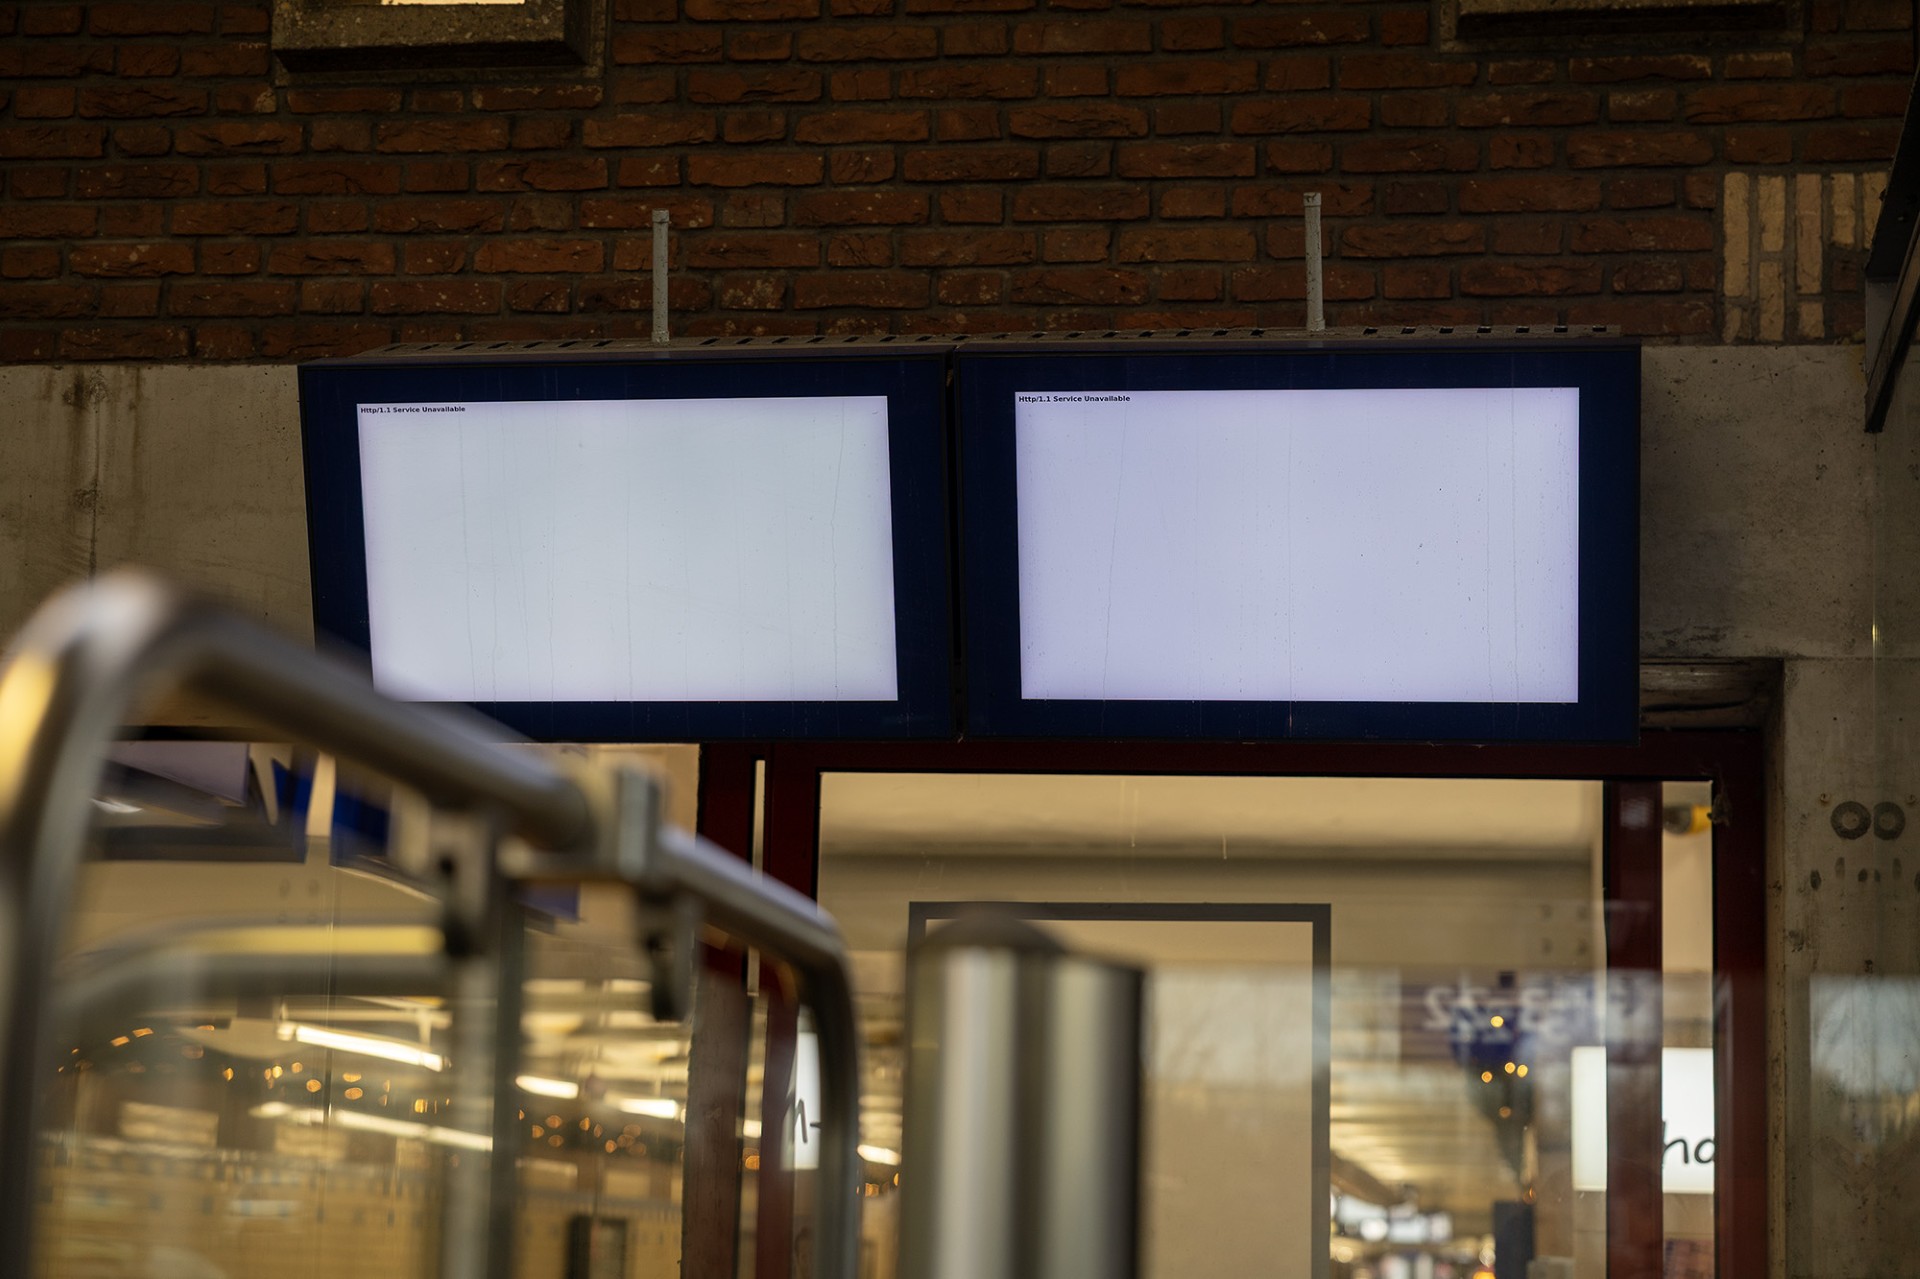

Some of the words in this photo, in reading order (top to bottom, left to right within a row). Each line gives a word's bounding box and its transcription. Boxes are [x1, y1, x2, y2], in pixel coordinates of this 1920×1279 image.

[1018, 395, 1051, 404] Http/1.1
[1053, 395, 1083, 403] Service
[1084, 395, 1131, 403] Unavailable
[360, 406, 392, 415] Http/1.1
[393, 406, 421, 414] Service
[422, 405, 466, 413] Unavailable
